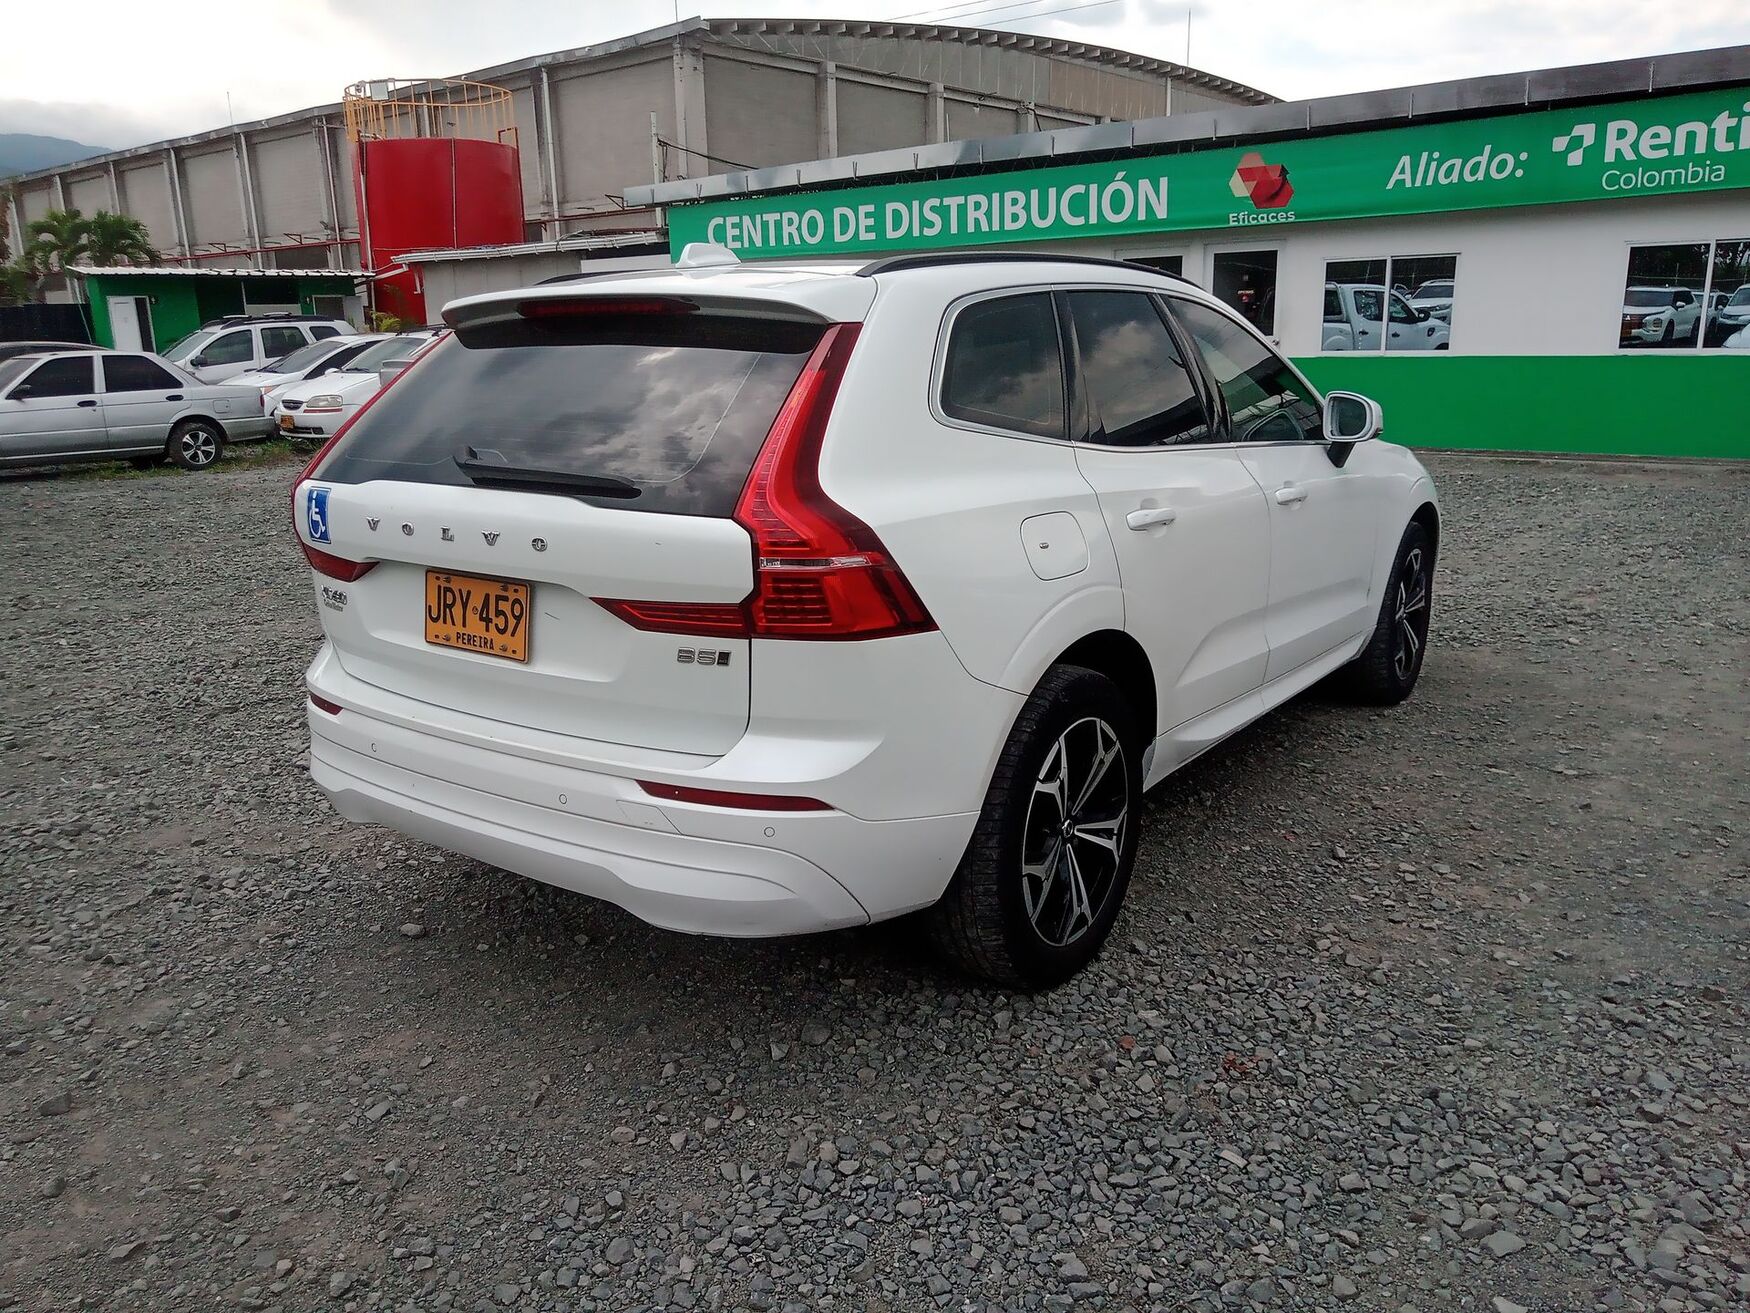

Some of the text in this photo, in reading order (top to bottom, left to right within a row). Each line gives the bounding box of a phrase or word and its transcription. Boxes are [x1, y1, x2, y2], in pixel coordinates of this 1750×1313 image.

[1385, 144, 1529, 190] Aliado:
[1601, 160, 1726, 191] Colombia
[707, 171, 1168, 249] CENTRO DE DISTRIBUCIÓN
[1229, 211, 1296, 225] Eficaces
[365, 515, 548, 553] VOLVO
[456, 631, 495, 651] PEREIRA
[677, 646, 717, 666] B5
